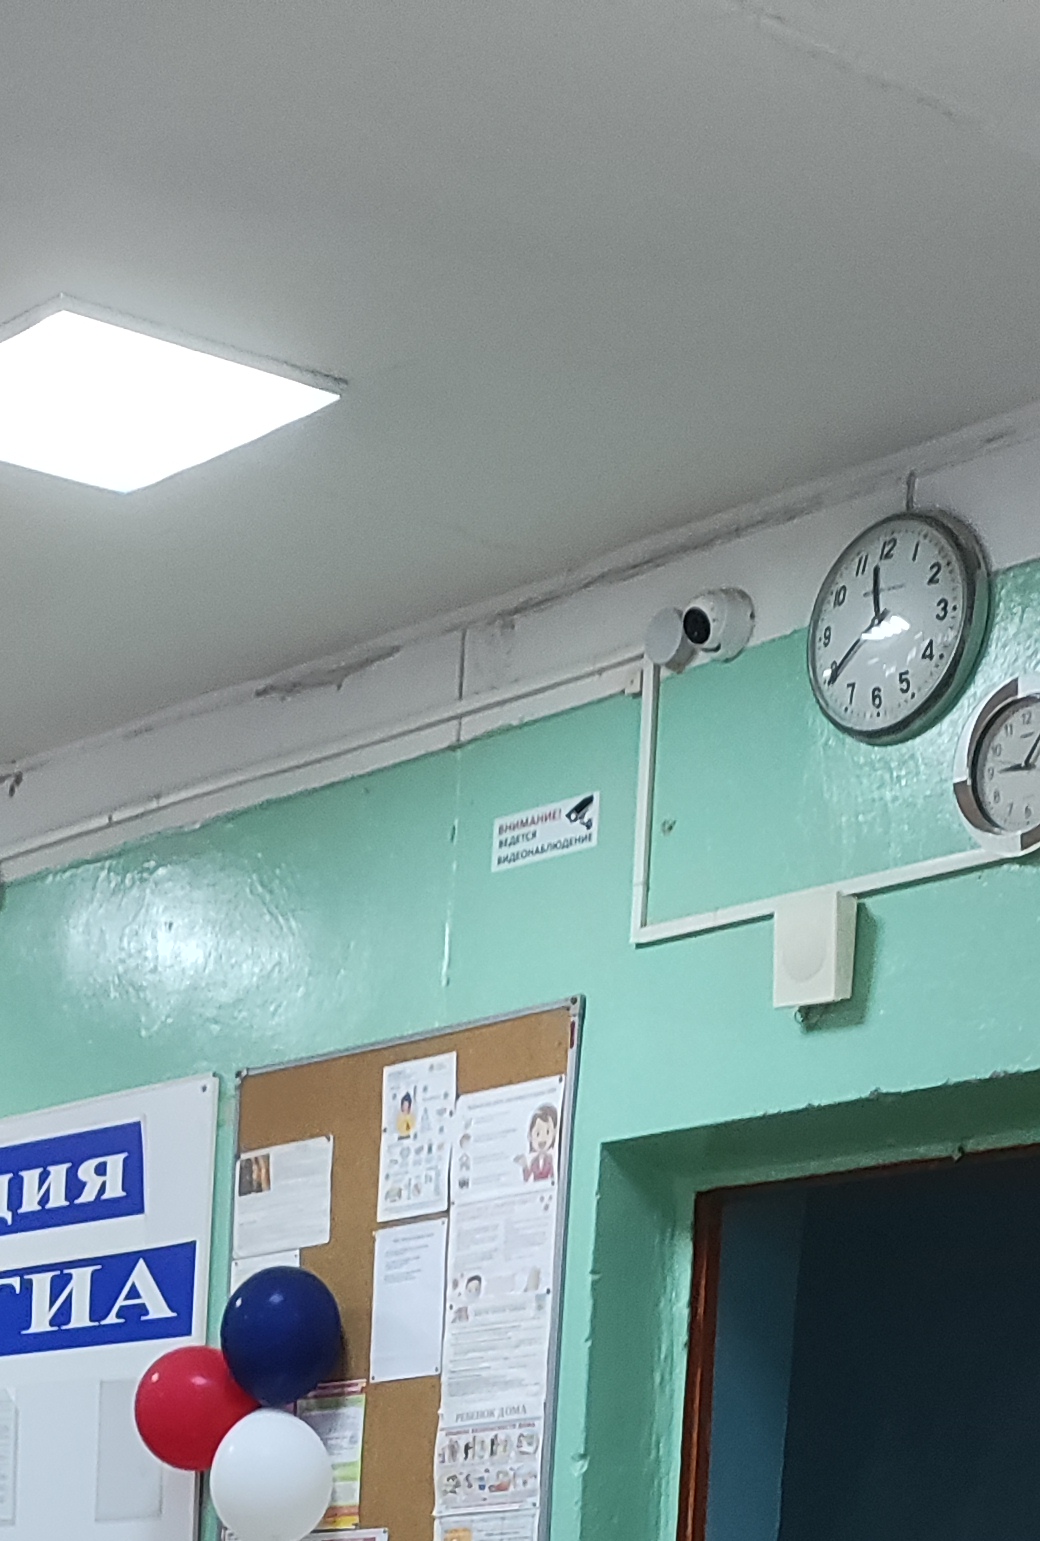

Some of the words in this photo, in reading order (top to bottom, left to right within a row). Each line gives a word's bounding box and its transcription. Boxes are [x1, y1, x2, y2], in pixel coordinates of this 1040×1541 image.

[879, 537, 898, 561] 12
[912, 541, 920, 562] 1
[855, 554, 869, 577] 11
[926, 562, 942, 586] 2
[833, 585, 847, 609] 10
[936, 598, 948, 621] 3
[823, 626, 832, 647] 9
[921, 638, 935, 661] 4
[846, 682, 856, 705] 7
[898, 670, 911, 694] 5
[871, 686, 883, 709] 6
[1022, 710, 1033, 725] 12
[498, 808, 562, 835] ВНИМАНИЕ!
[497, 832, 593, 865] ВИДЕОНАБЛЮДЕНИЕ
[498, 830, 537, 849] ВЕДЕТСЯ
